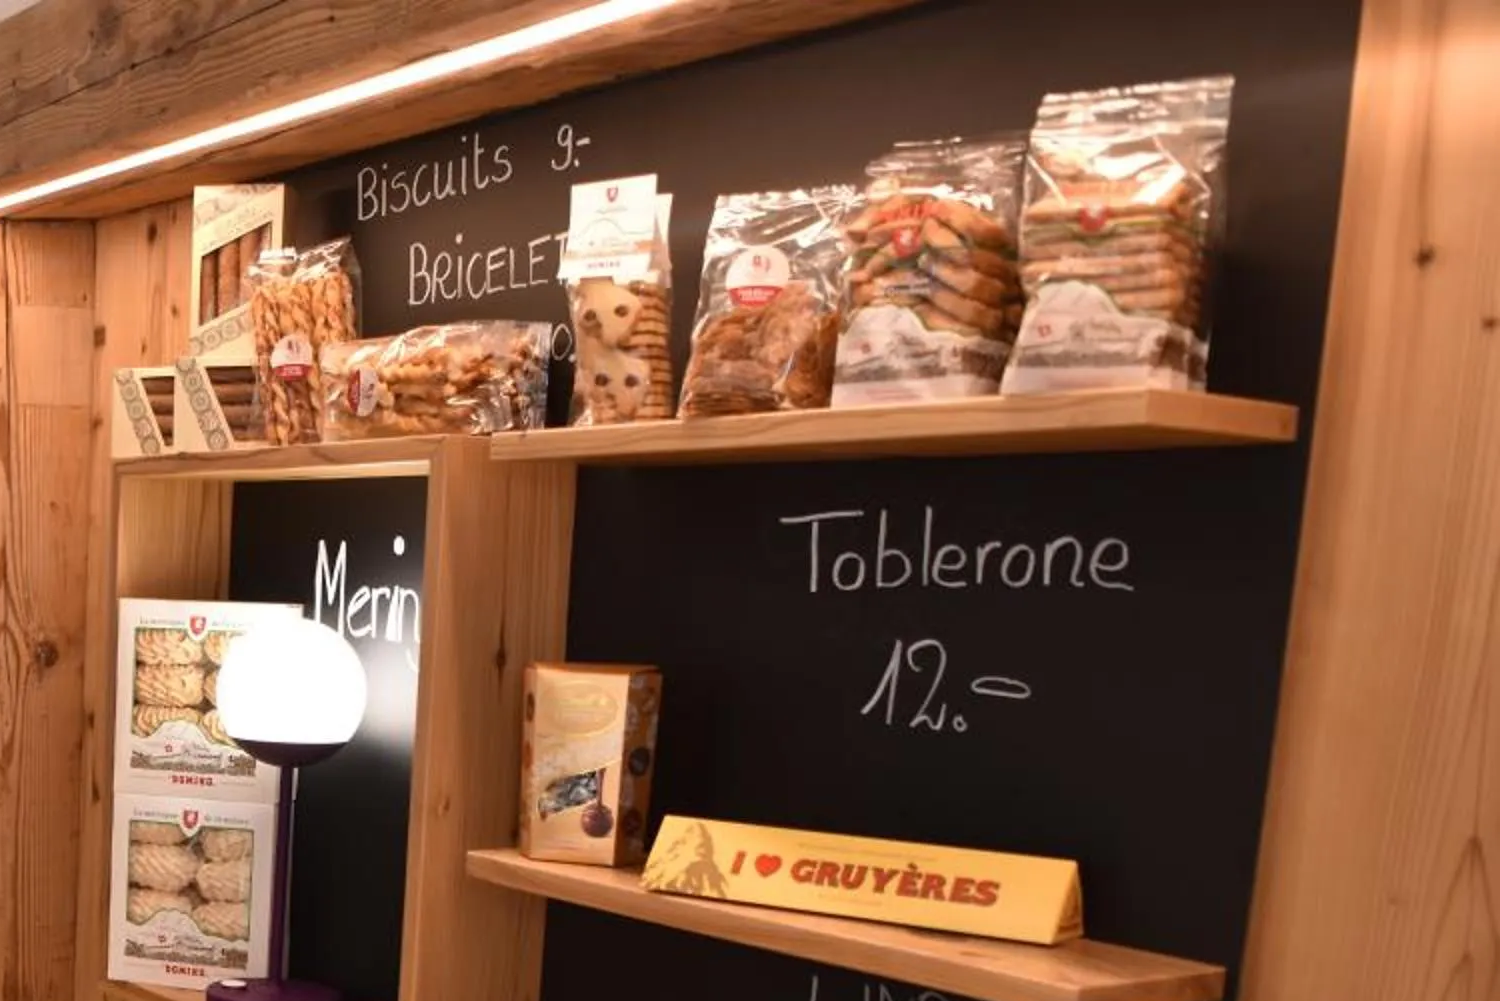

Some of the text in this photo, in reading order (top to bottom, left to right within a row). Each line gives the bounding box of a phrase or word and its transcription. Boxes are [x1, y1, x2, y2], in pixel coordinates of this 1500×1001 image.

[356, 130, 514, 222] Biscuits
[779, 504, 1135, 593] Toblerone
[729, 849, 1001, 908] I GRUYÈRES
